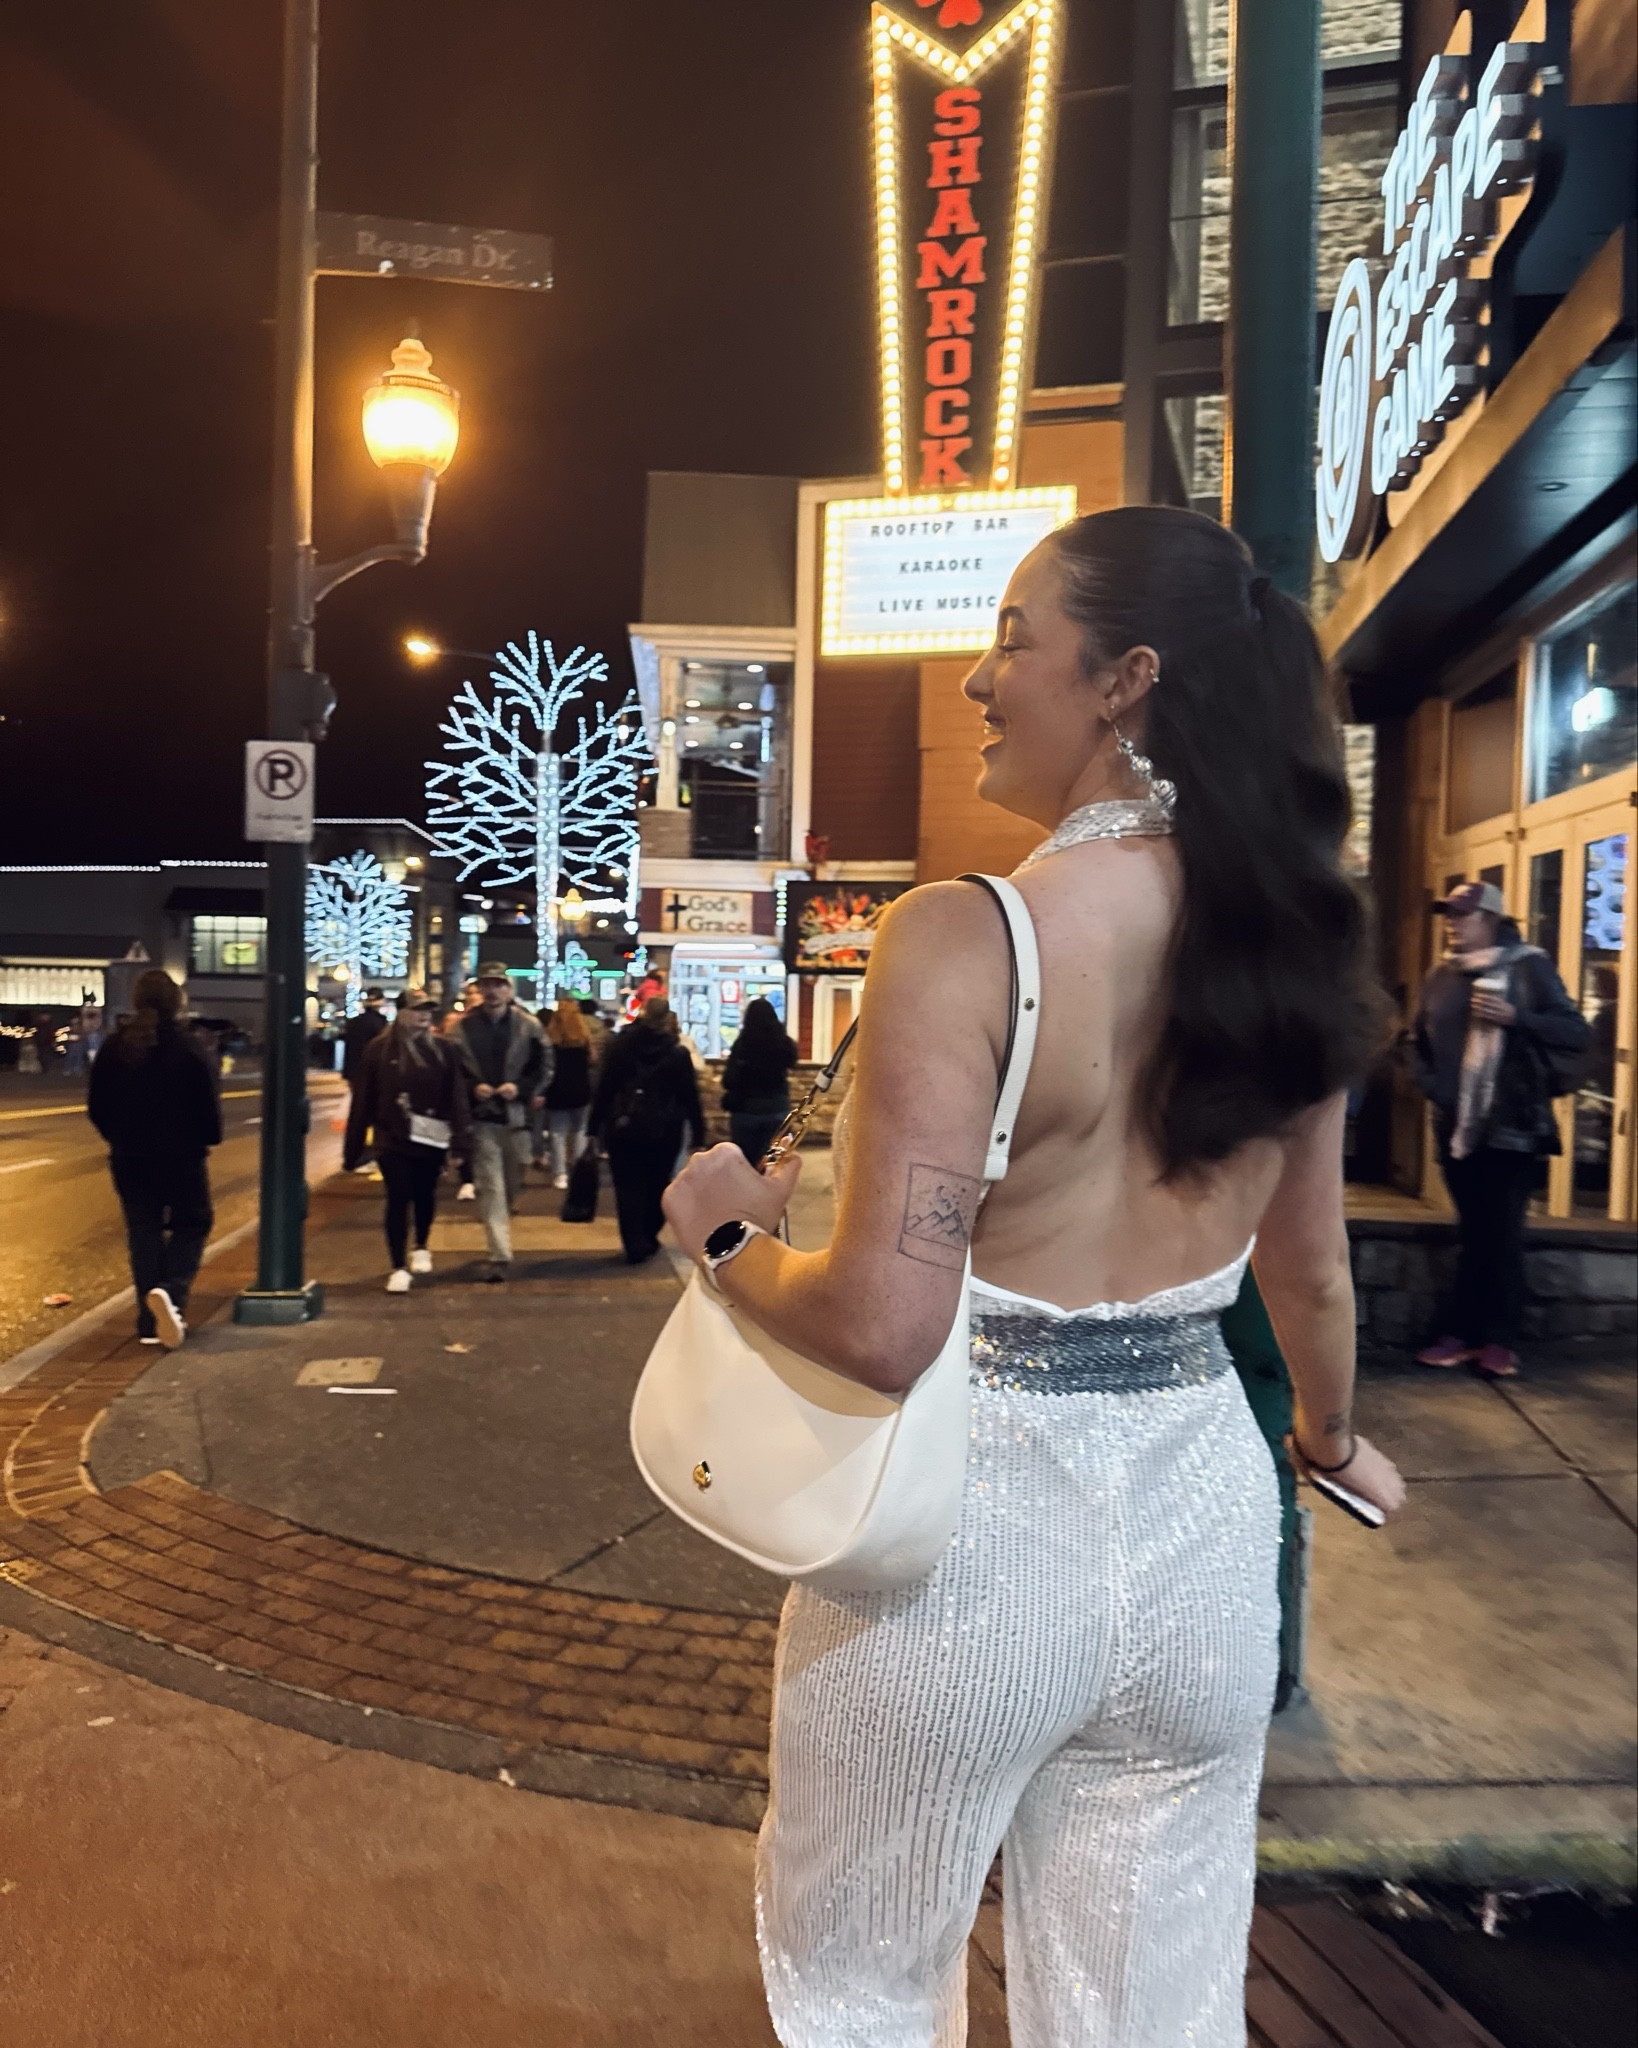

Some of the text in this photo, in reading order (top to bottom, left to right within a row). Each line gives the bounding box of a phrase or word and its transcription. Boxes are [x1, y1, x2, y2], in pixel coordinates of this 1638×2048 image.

[1382, 54, 1440, 255] THE
[1375, 42, 1506, 381] ESCAPE
[356, 229, 463, 269] Reagan
[917, 87, 987, 488] SHAMROCK
[1371, 277, 1457, 495] GAME
[871, 517, 1009, 537] ROOFTOP BAR
[899, 558, 983, 574] KARAOKE
[879, 595, 998, 613] LIVE MUSIC
[688, 894, 738, 913] God's
[687, 915, 748, 933] Grace
